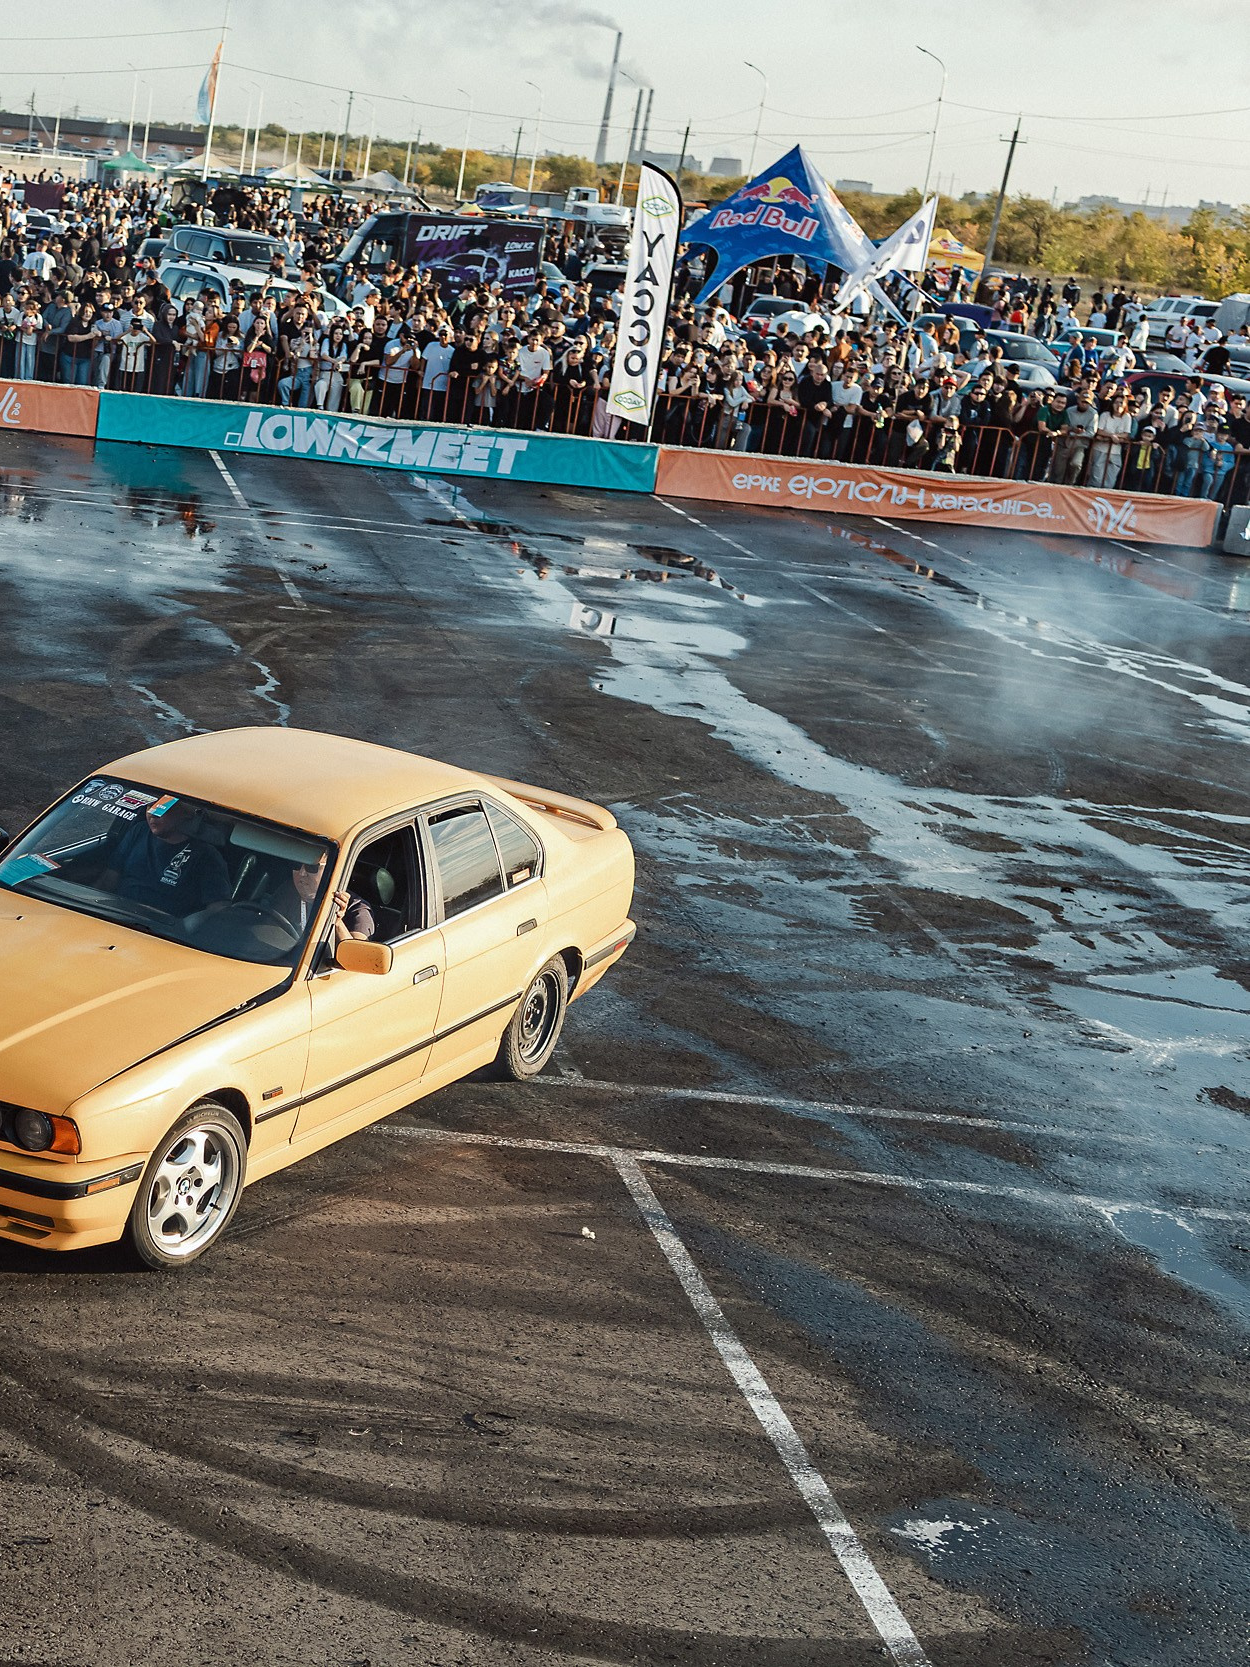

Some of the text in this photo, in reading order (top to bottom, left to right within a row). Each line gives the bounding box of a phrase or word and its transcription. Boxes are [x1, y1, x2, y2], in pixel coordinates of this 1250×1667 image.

[709, 204, 765, 229] Red
[759, 206, 820, 241] Bull
[415, 224, 488, 241] DRIFT
[505, 241, 536, 250] LOW KZ
[508, 267, 535, 278] КАССА
[101, 803, 138, 821] GARAGE
